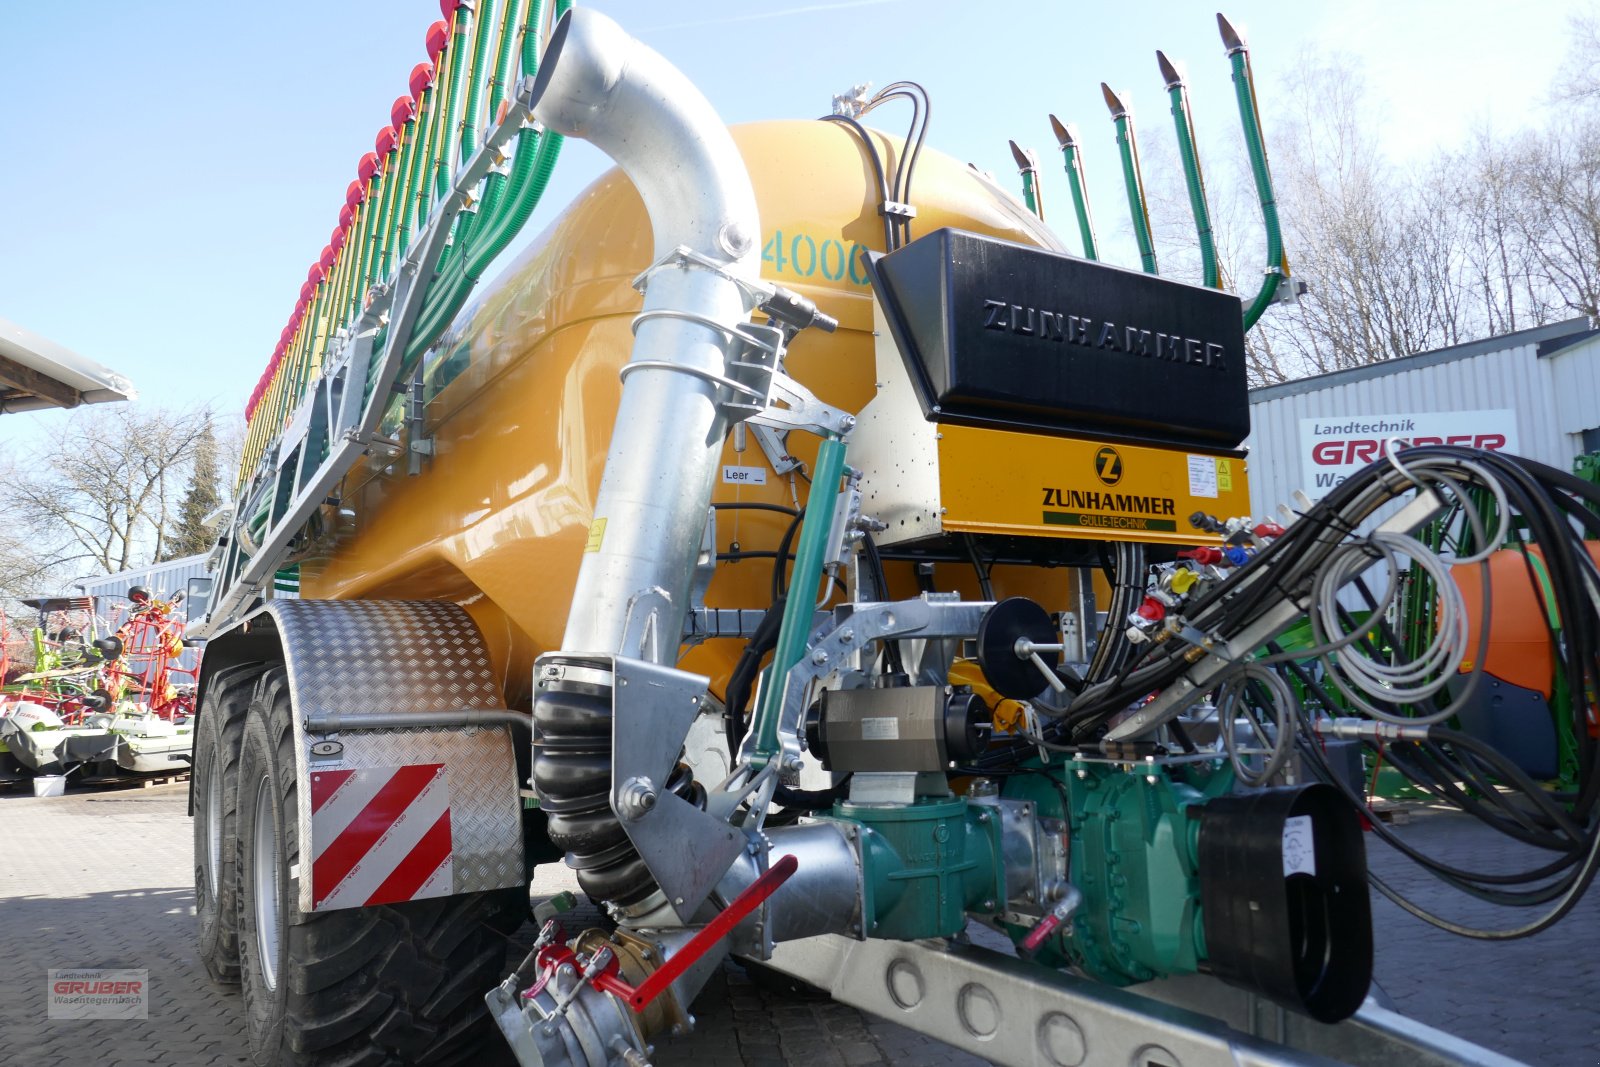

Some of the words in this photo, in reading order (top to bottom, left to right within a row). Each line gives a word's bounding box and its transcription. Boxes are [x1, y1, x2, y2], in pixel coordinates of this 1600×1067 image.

[984, 299, 1226, 370] ZUNHAMMER
[1314, 419, 1415, 435] Landtechnik
[1312, 434, 1506, 465] GRR
[725, 469, 749, 480] Leer
[1042, 488, 1176, 515] ZUNHAMMER
[1079, 514, 1148, 530] GÜLLE-TECHNIK
